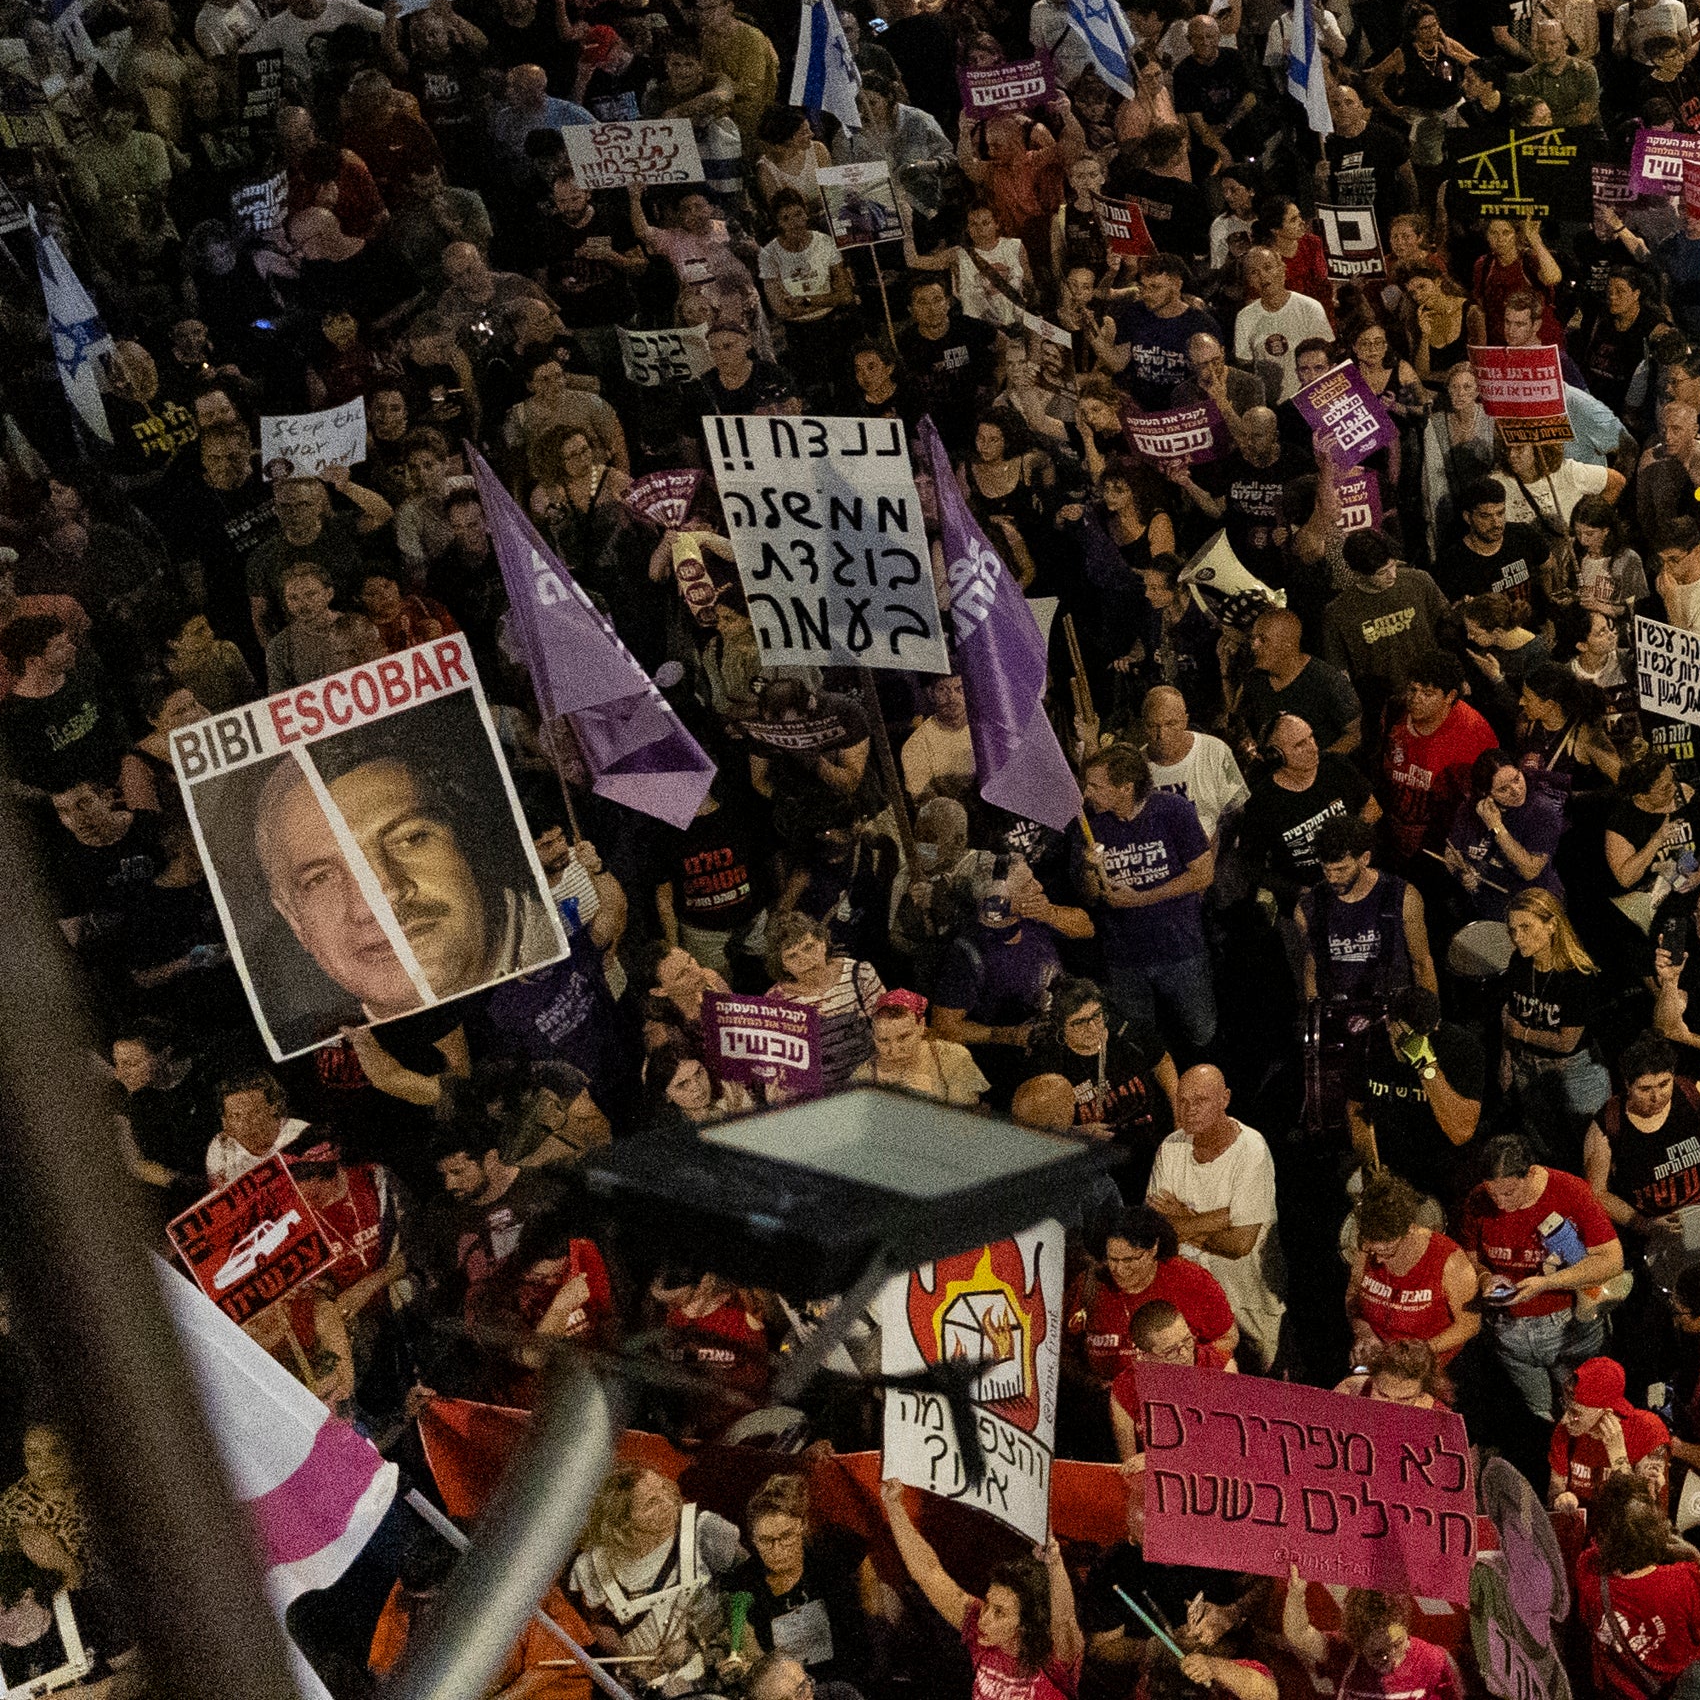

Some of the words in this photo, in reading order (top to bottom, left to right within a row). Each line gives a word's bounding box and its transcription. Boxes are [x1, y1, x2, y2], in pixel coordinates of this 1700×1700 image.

[973, 79, 1040, 101] עכשיו
[1319, 209, 1375, 256] כן
[278, 440, 327, 459] war
[1137, 429, 1204, 454] עכשיו
[723, 488, 909, 534] ממשלה
[752, 540, 922, 593] בוגדת
[750, 595, 933, 653] בעמה
[174, 716, 264, 781] BIBI
[266, 639, 471, 747] ESCOBAR
[1657, 678, 1686, 711] לבנון
[715, 1001, 760, 1016] העסקה
[760, 1007, 778, 1018] את
[779, 1008, 807, 1022] לקבל
[728, 1031, 804, 1063] עכשיו
[222, 1234, 321, 1318] עכשיו
[899, 1394, 946, 1432] מה
[1148, 1399, 1375, 1476] מפקירים
[1402, 1434, 1466, 1493] לא
[1154, 1468, 1287, 1528] בשטח
[1303, 1483, 1474, 1557] חיילים
